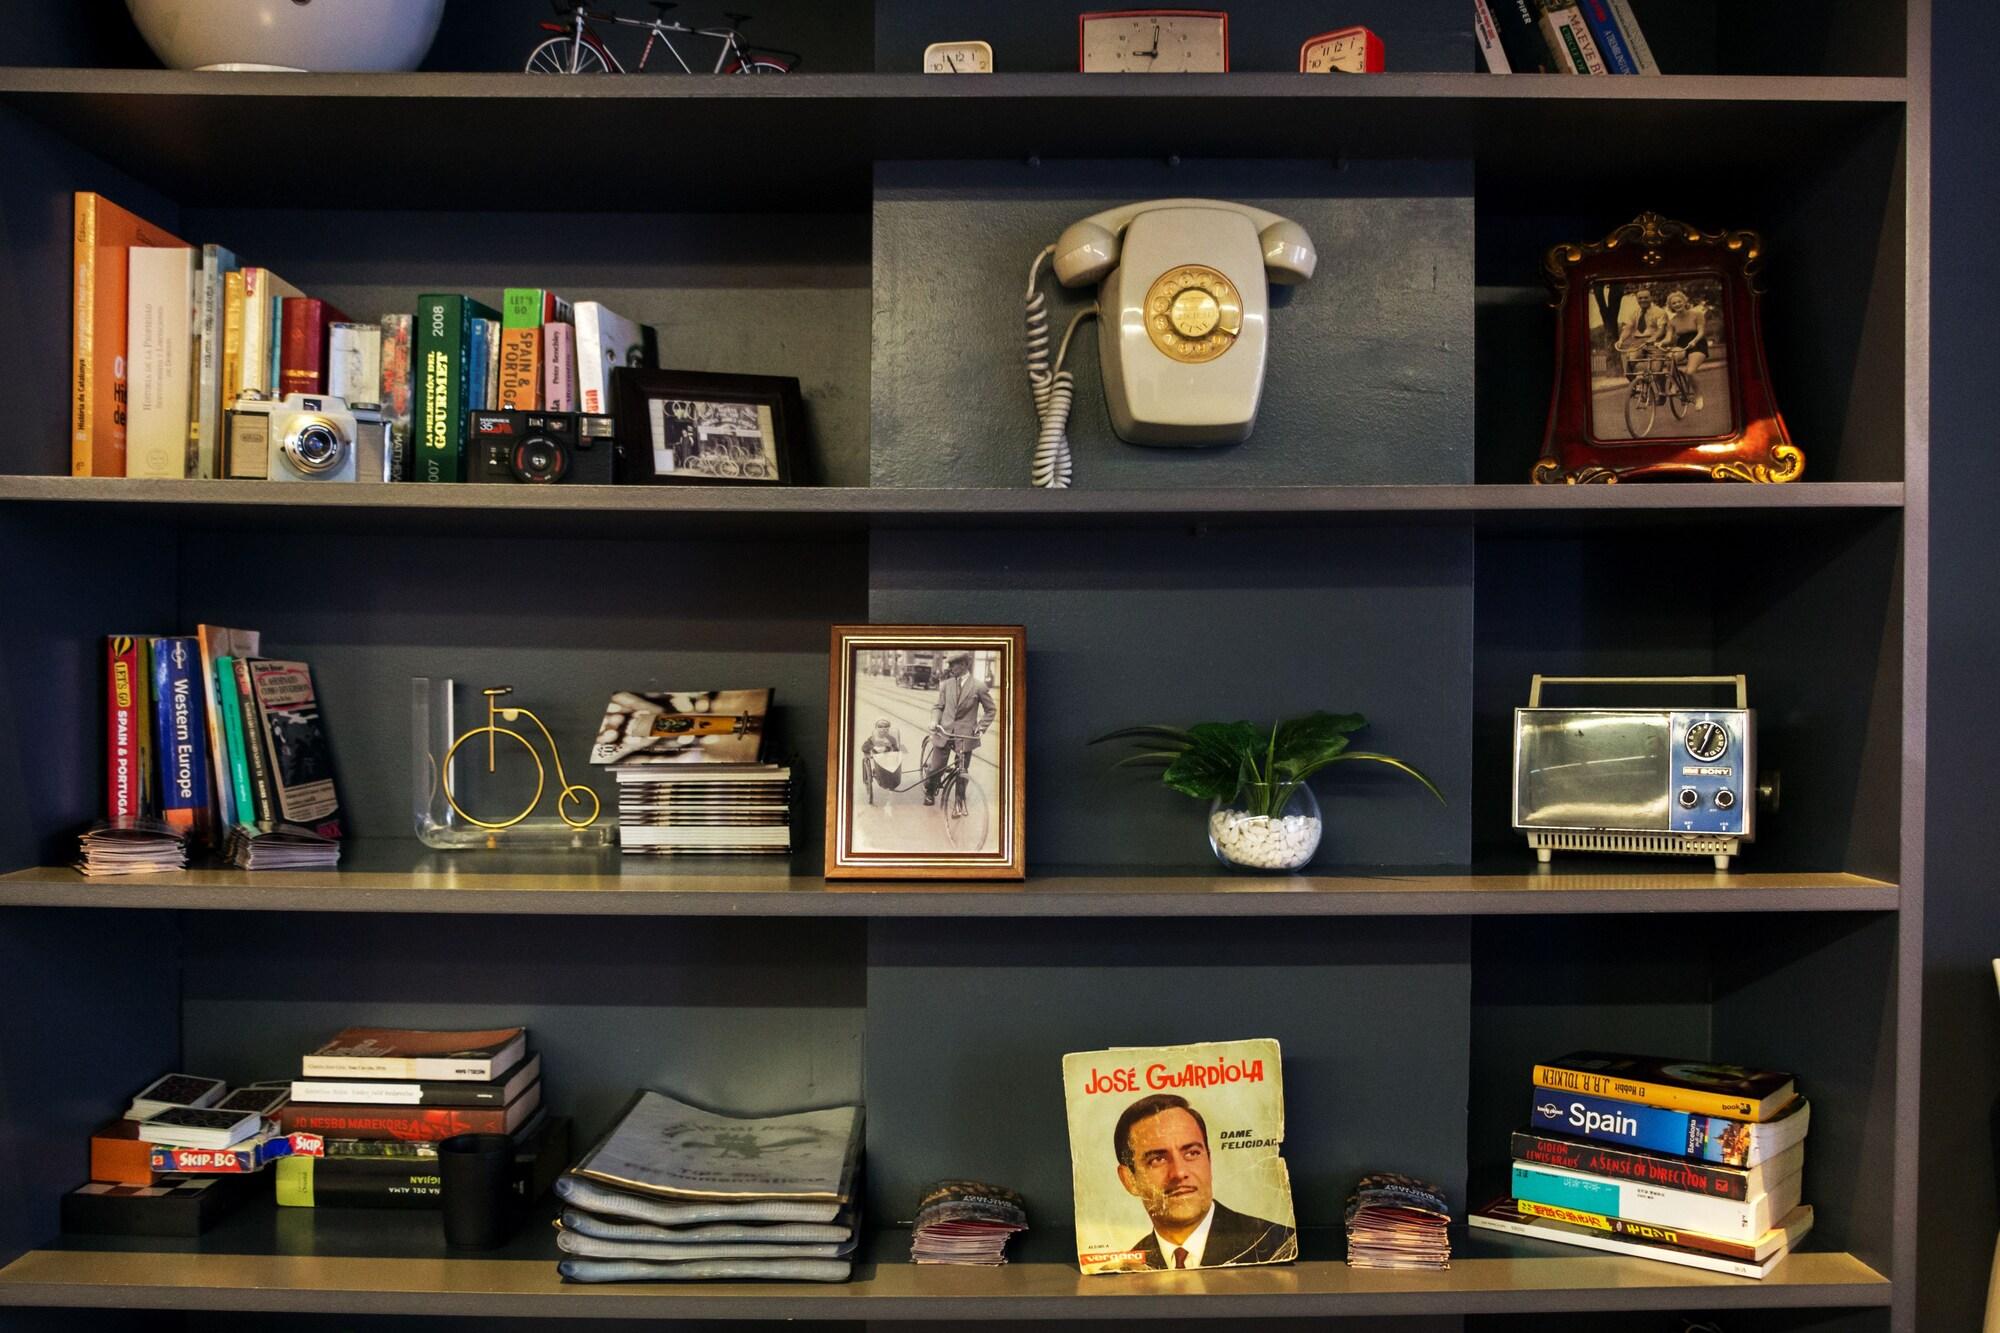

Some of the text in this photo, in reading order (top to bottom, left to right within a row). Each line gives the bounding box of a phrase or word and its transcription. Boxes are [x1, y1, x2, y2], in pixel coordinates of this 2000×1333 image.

[1568, 14, 1595, 61] MAEVE
[432, 305, 444, 337] 2008
[427, 351, 435, 371] DEL
[518, 332, 533, 388] SPAIN &
[552, 331, 561, 384] Peter Benchley
[77, 358, 86, 392] Catalunya
[503, 343, 519, 408] PORTUGA
[434, 351, 448, 449] GOURMET
[426, 433, 434, 447] LA
[480, 422, 494, 431] 35
[118, 691, 129, 706] GO
[117, 710, 128, 746] SPAIN
[174, 678, 192, 799] Western Europe
[117, 747, 128, 756] &
[1542, 1068, 1579, 1090] TOLKIEN
[1615, 1082, 1637, 1096] Hobbit
[294, 1118, 307, 1129] JO
[1568, 1102, 1638, 1137] Spain
[1220, 1129, 1253, 1139] DAME
[1687, 1119, 1697, 1154] Barcelona
[1537, 1141, 1569, 1155] GIDEON
[1590, 1154, 1708, 1190] A SENSE OF DIRECTION
[1627, 1223, 1679, 1244] モロッコ
[1086, 1252, 1143, 1263] vergara
